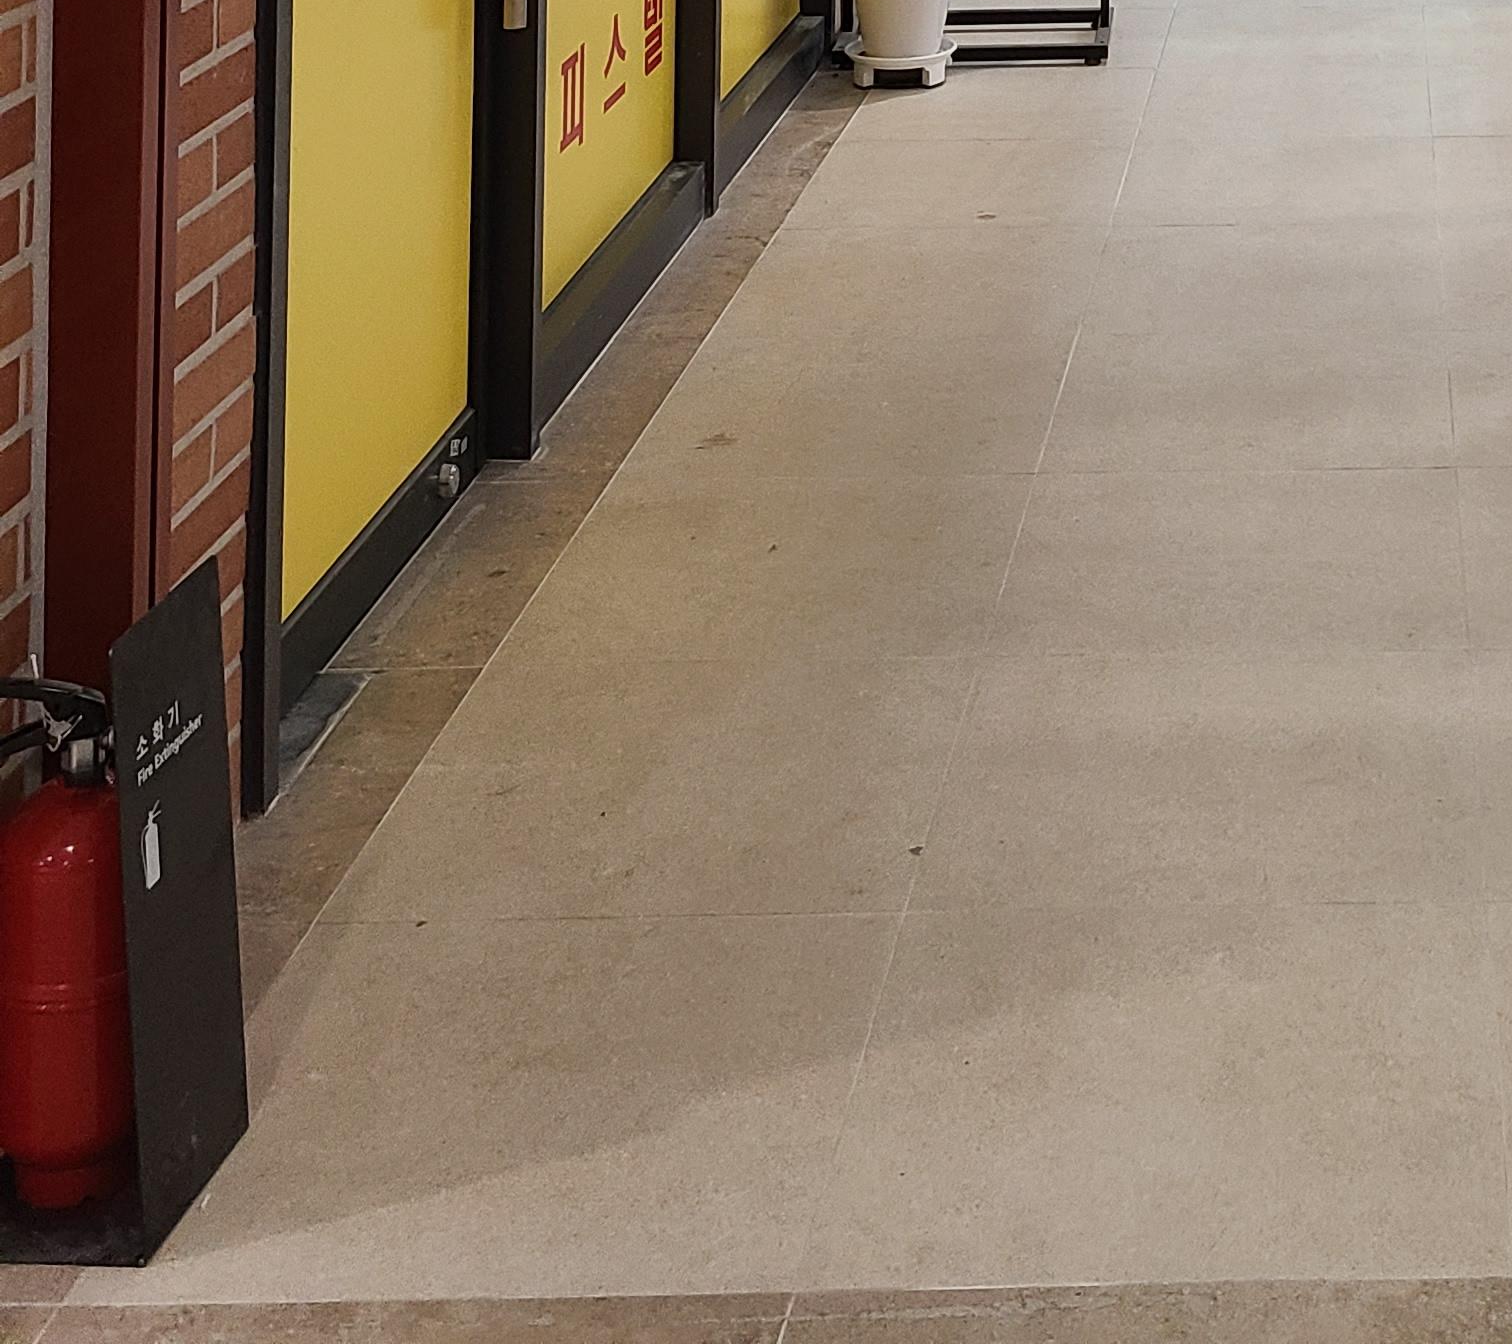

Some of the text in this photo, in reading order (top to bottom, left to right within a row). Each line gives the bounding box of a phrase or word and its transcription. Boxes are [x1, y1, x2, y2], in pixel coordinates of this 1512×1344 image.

[136, 700, 179, 761] 소화기
[138, 713, 203, 787] Fire Extinguisher
